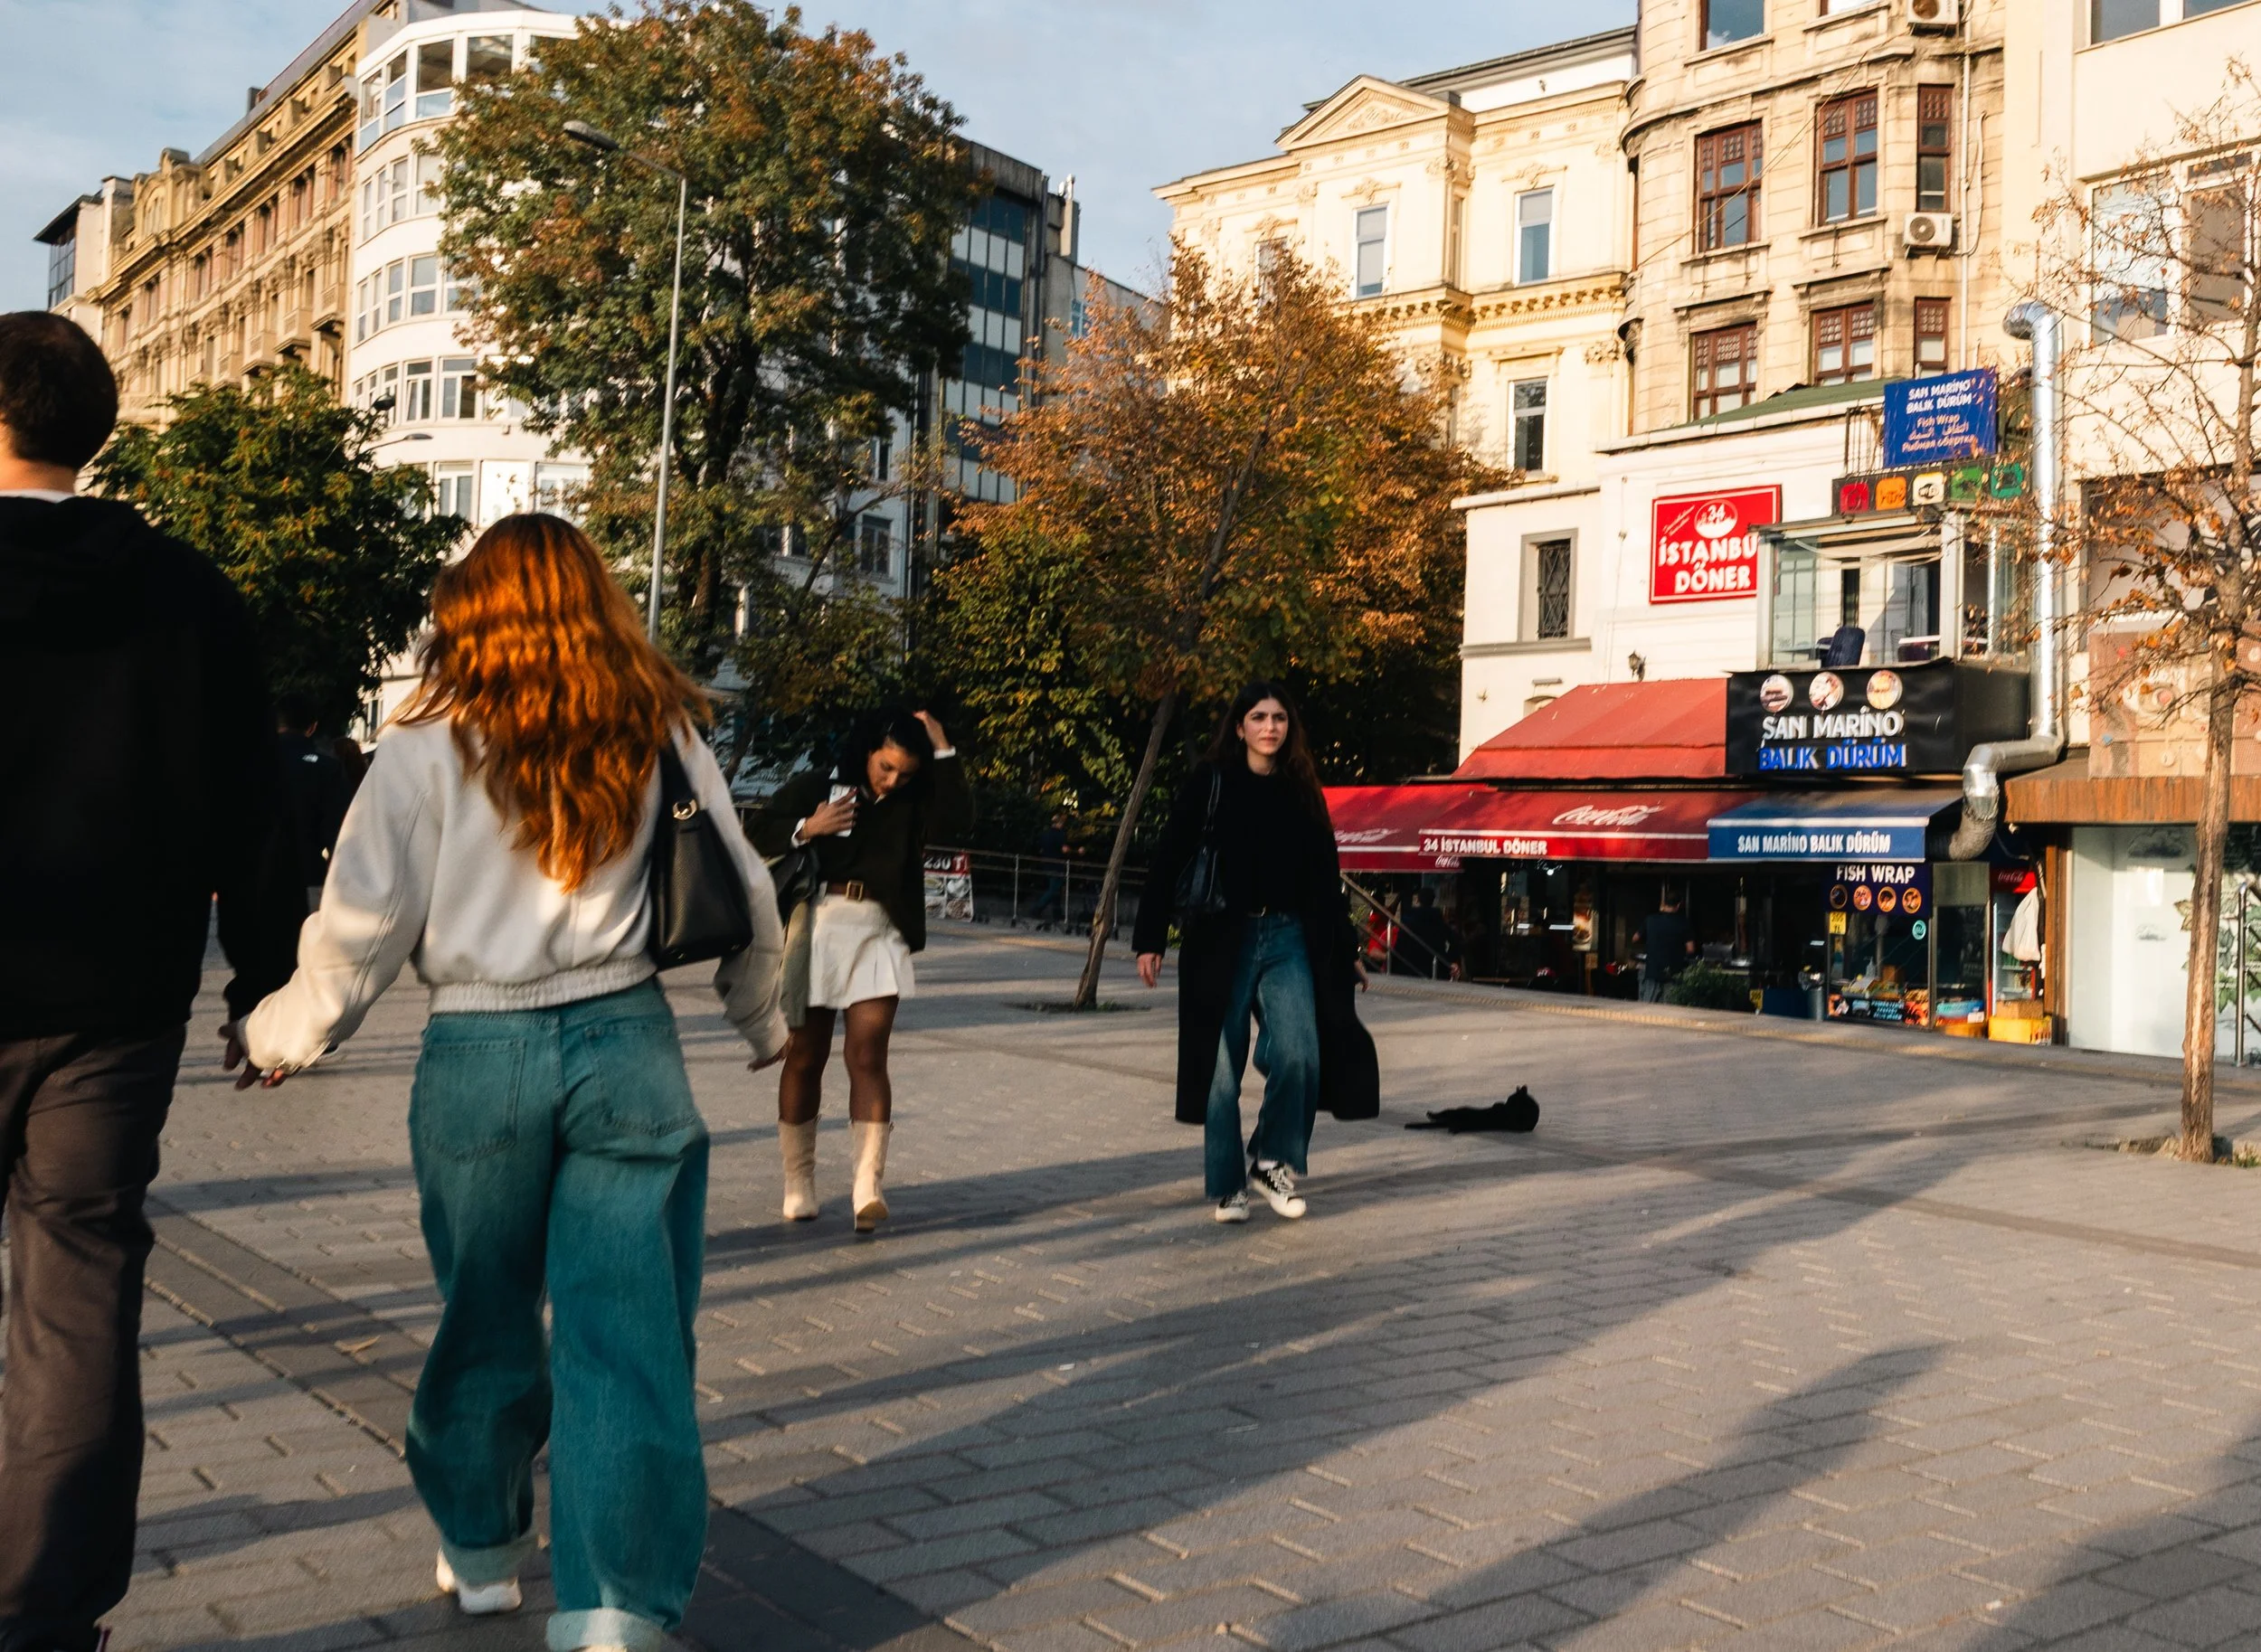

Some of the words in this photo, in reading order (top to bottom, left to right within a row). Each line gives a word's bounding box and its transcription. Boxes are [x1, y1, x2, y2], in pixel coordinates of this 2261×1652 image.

[1908, 385, 1929, 401] SAN
[1931, 379, 1972, 397] MARİNO
[1906, 398, 1935, 414] BALIK
[1936, 392, 1972, 410] DÜRÜM
[1917, 416, 1935, 429] Fish
[1936, 413, 1961, 426] Wrap
[1708, 504, 1726, 523] 34
[1658, 532, 1758, 567] İSTANBU
[1674, 561, 1752, 594] DÖNER
[1762, 715, 1808, 741] SAN
[1812, 705, 1906, 739] MARİNO
[1758, 745, 1820, 772] BALIK
[1826, 737, 1907, 770] DÜRÜM
[1424, 837, 1439, 853] 34
[1441, 835, 1501, 854] İSTANBUL
[1502, 837, 1547, 855] DÖNER
[1737, 834, 1759, 853] SAN
[1763, 831, 1807, 854] MARİNO
[1810, 834, 1843, 854] BALIK
[1846, 830, 1891, 854] DÜRÜM
[1837, 864, 1866, 883] FISH
[1870, 865, 1916, 884] WRAP
